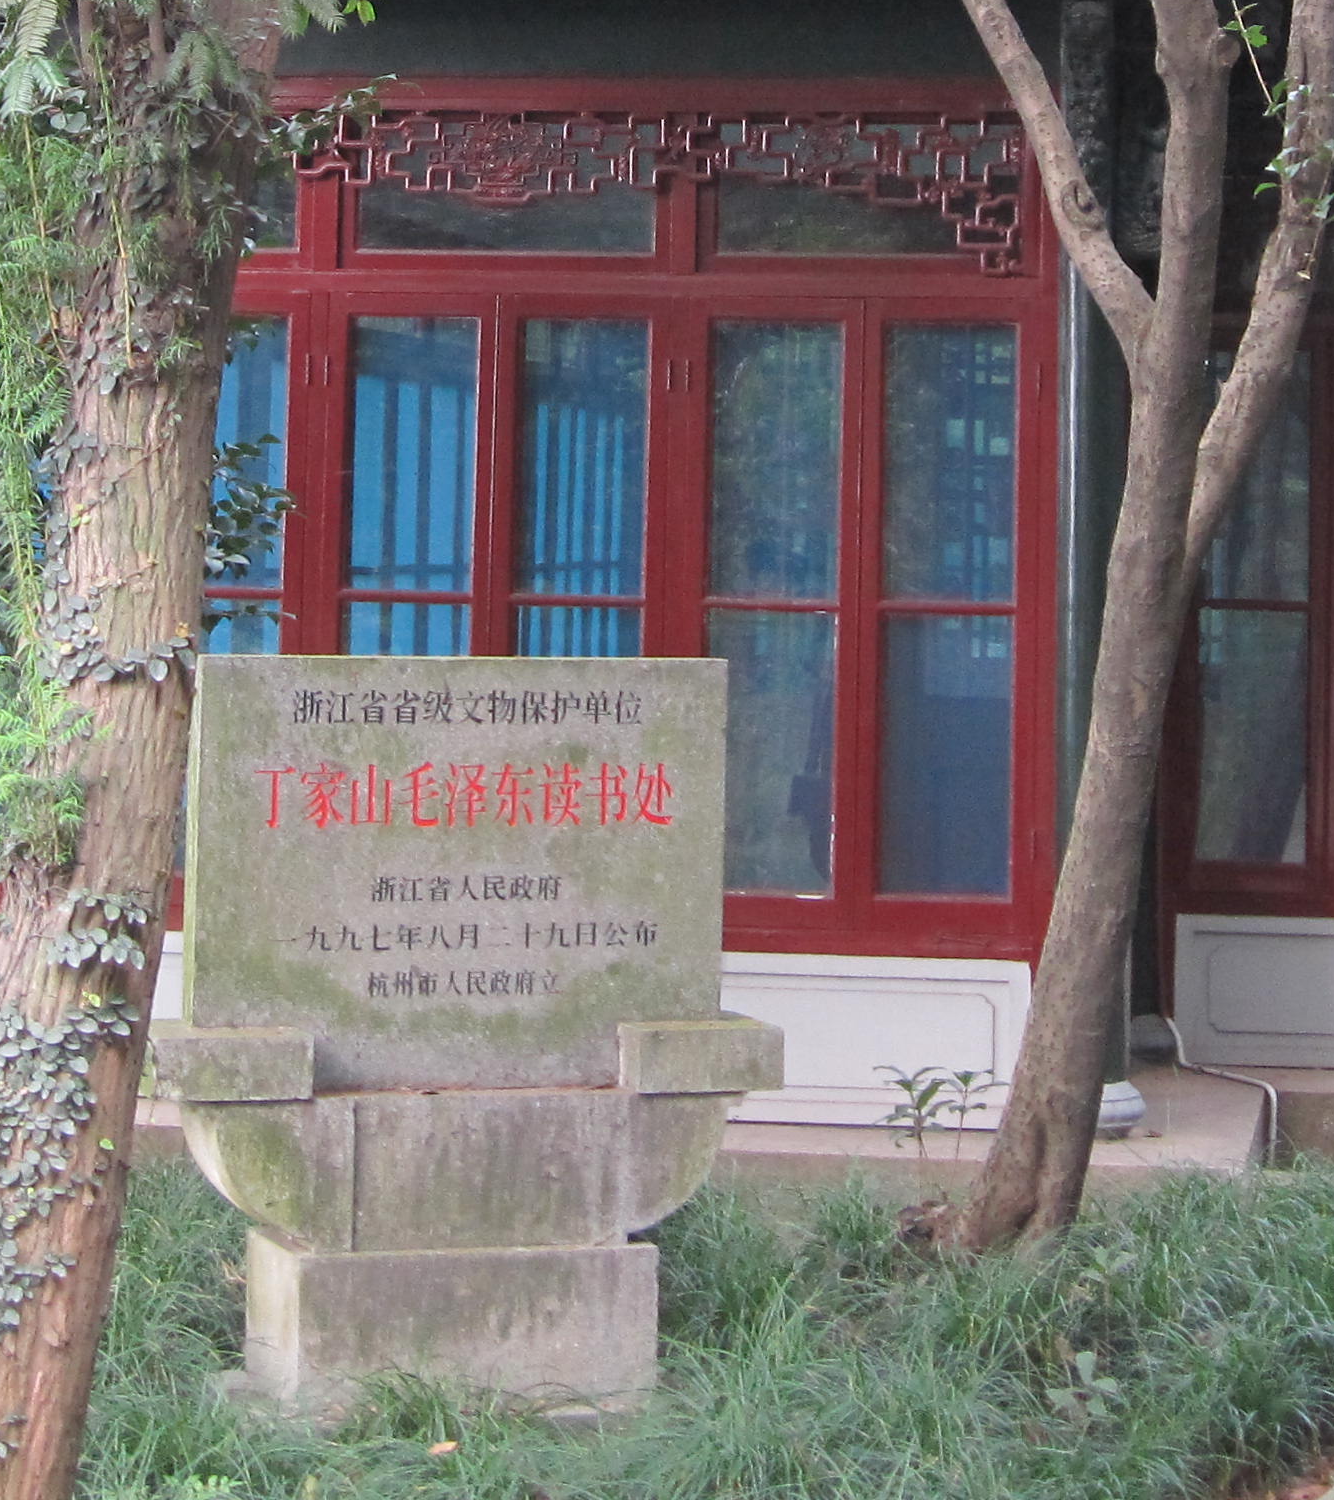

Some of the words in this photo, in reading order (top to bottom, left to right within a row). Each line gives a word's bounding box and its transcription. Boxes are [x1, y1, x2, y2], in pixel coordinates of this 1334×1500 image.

[291, 689, 644, 726] 浙江省省级文物保护单位
[255, 761, 674, 829] 丁家山毛泽东读书处
[371, 874, 563, 903] 浙江省人民政府
[269, 920, 659, 953] 一九九七年八月二十九日公布
[367, 969, 563, 999] 杭州市人民政府立
